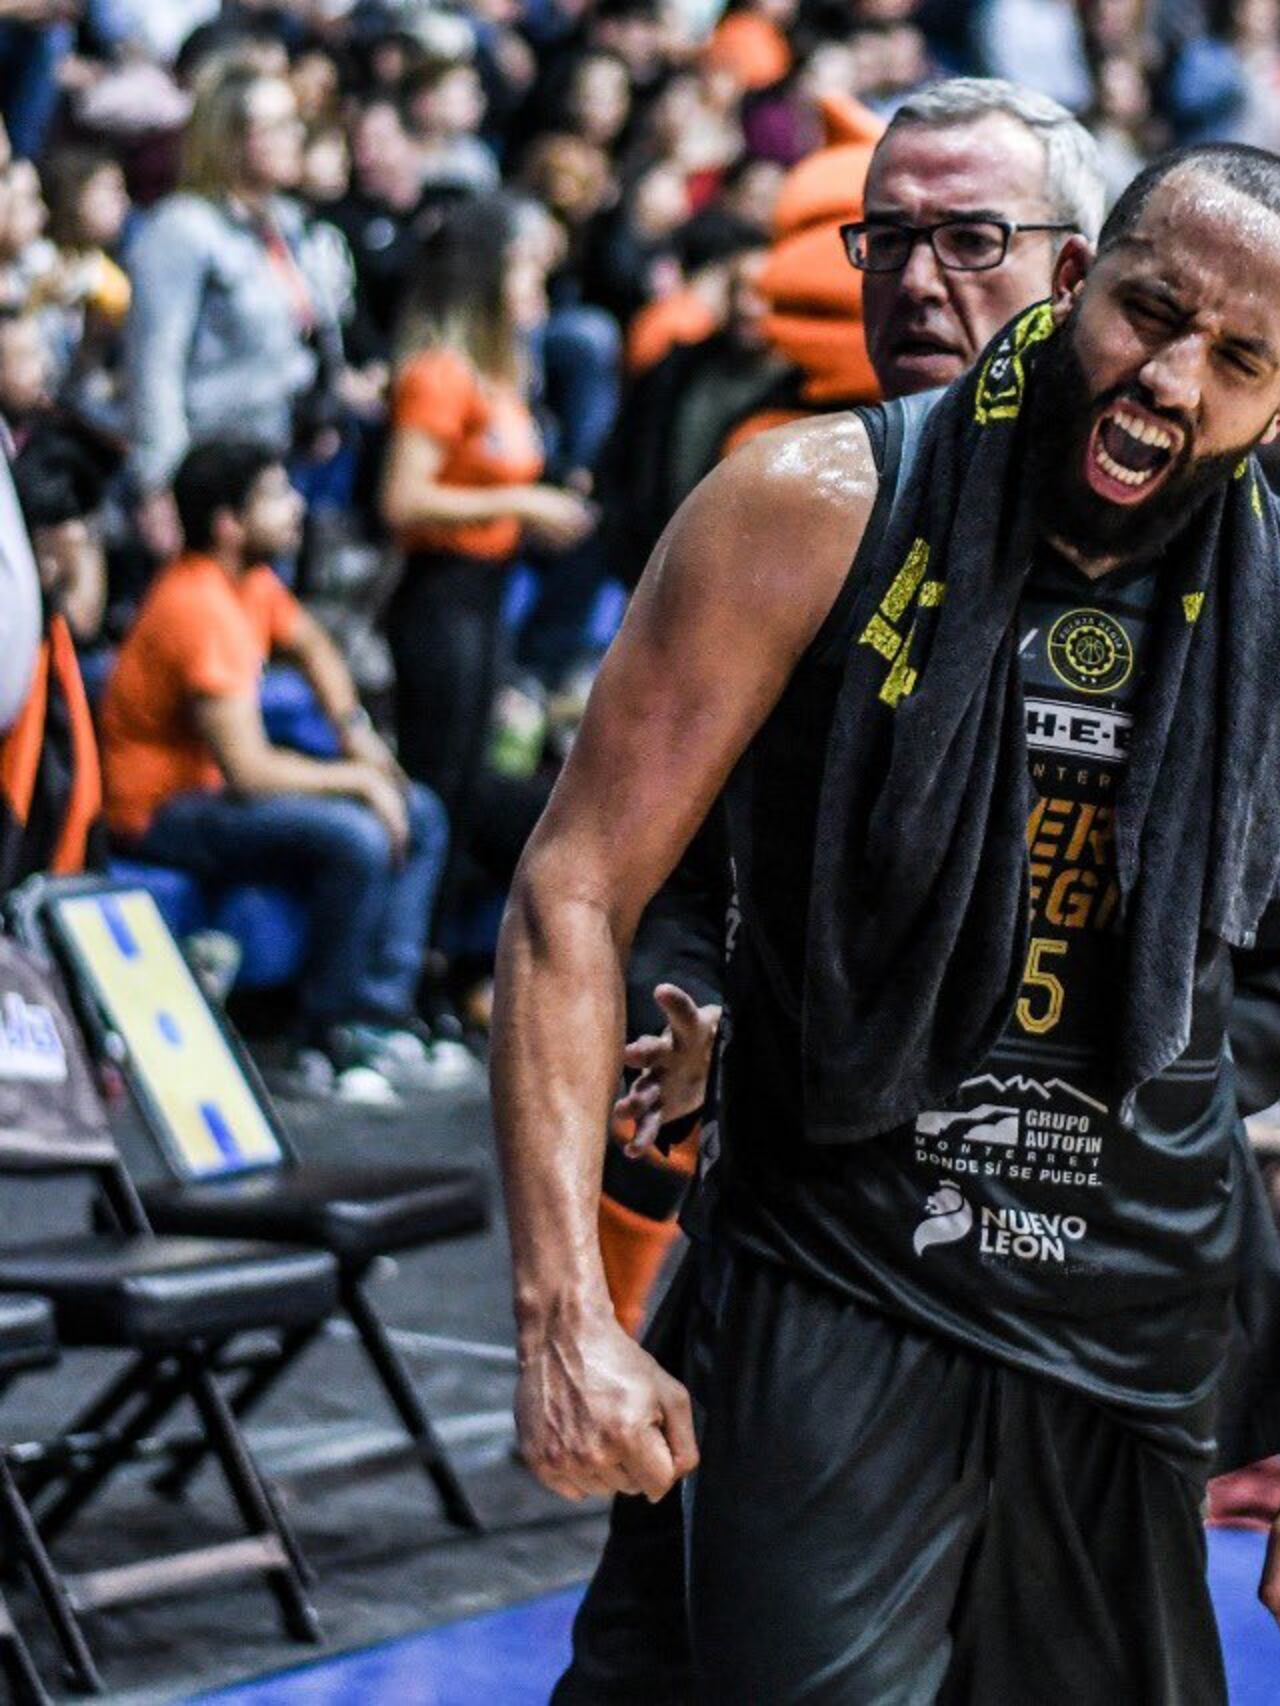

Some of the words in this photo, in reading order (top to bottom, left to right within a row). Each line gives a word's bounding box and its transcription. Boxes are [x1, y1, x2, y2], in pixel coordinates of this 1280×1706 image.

[1033, 762, 1112, 787] NTER
[1026, 797, 1114, 865] ER
[1016, 937, 1069, 1034] 5
[1025, 1108, 1091, 1134] GRUPO
[914, 1136, 1100, 1168] MONTERREY
[1024, 1131, 1103, 1154] AUTOFIN
[915, 1149, 979, 1174] DONDE
[1008, 1164, 1033, 1180] SE
[1039, 1168, 1103, 1187] PUEDE.
[980, 1205, 1088, 1241] NUEVO
